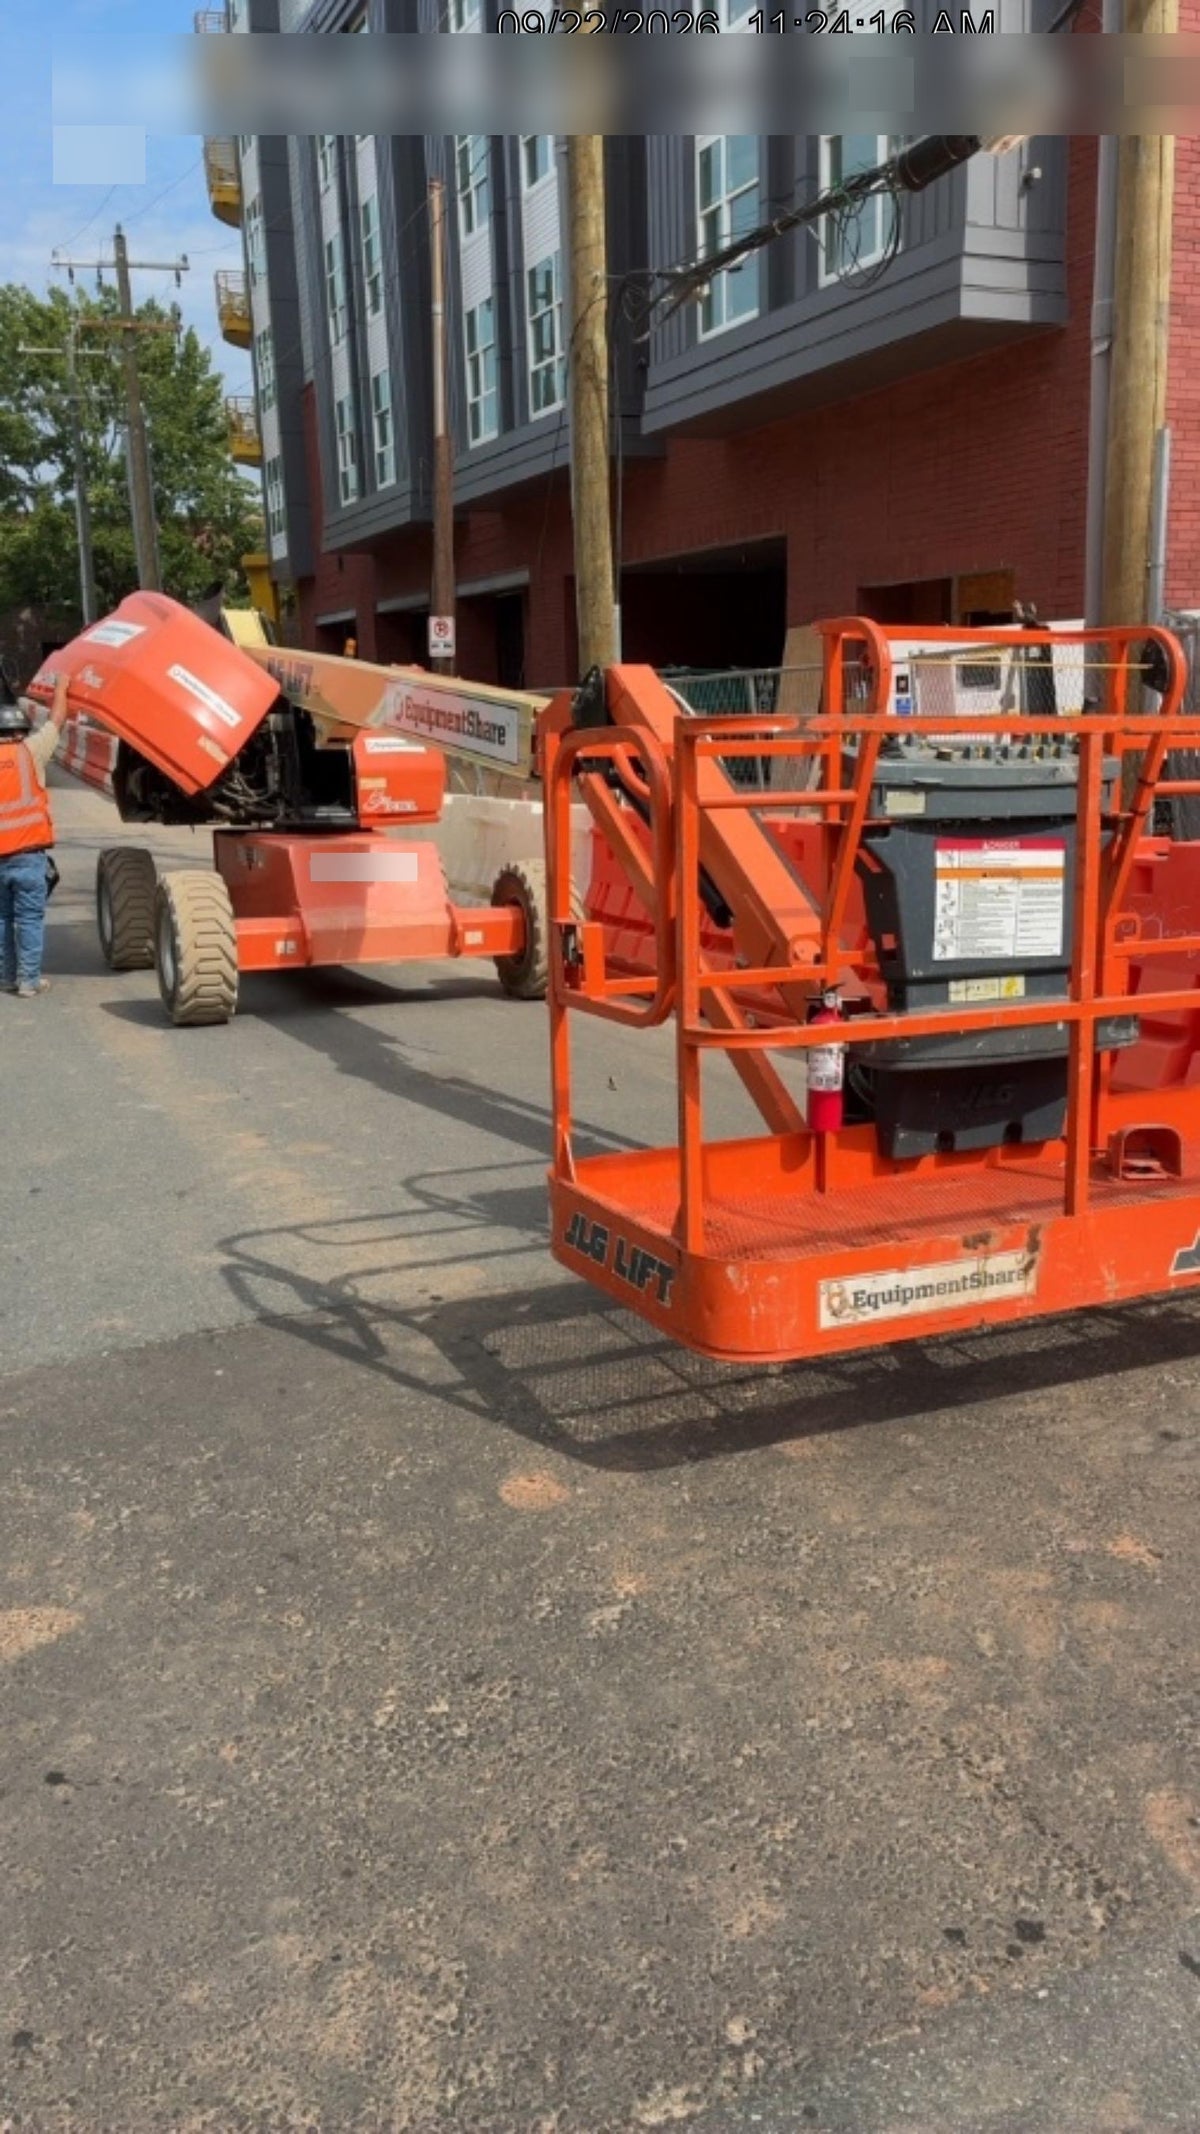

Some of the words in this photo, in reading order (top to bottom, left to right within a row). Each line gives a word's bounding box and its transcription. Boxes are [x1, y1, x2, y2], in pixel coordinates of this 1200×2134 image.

[405, 695, 507, 746] EquipmentShare
[563, 1212, 609, 1266] JLG
[611, 1235, 678, 1308] LIFT
[852, 1268, 1027, 1310] EquipmentShare
